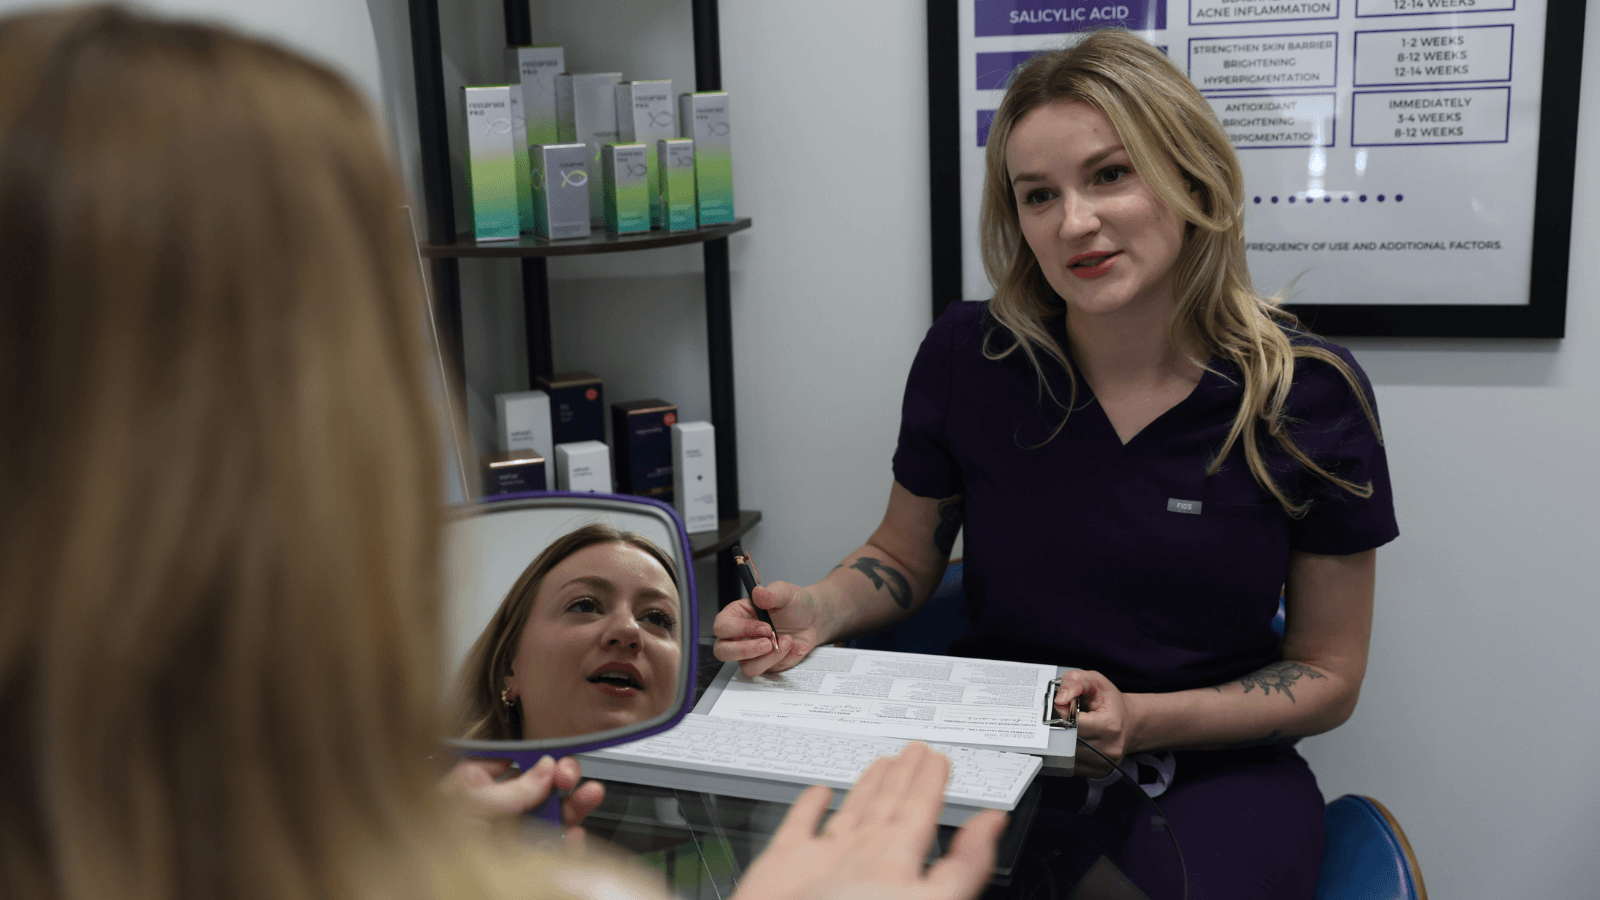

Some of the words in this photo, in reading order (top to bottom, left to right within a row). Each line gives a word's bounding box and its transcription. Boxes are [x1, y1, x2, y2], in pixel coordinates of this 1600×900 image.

[1196, 8, 1231, 18] ACNE
[1234, 3, 1331, 17] INFLAMMATION
[1394, 0, 1423, 9] 12-14
[1428, 0, 1475, 8] WEEKS
[1009, 7, 1086, 24] SALICYLIC
[1089, 5, 1129, 20] ACID
[1193, 43, 1259, 55] STRENGTHEN
[1261, 43, 1285, 52] SKIN
[1288, 40, 1332, 51] BARRIER
[1401, 38, 1417, 48] 1-2
[1420, 36, 1464, 47] WEEKS
[1397, 52, 1420, 62] 8-12
[1423, 50, 1467, 61] WEEKS
[1223, 57, 1296, 69] BRIGHTENING
[1394, 67, 1422, 77] 12-14
[1425, 65, 1469, 76] WEEKS
[1204, 72, 1320, 85] HYPERPIGMENTATION
[1225, 102, 1296, 112] ANTIOXIDANT
[1389, 98, 1472, 109] IMMEDIATELY
[1223, 117, 1295, 127] BRIGHTENING
[1397, 114, 1415, 123] 3-4
[1418, 112, 1461, 123] WEEKS
[1394, 128, 1417, 138] 8-12
[1420, 126, 1463, 137] WEEKS
[1246, 242, 1310, 252] FREQUENCY
[1311, 242, 1326, 251] OF
[1329, 242, 1349, 251] USE
[1352, 242, 1377, 251] AND
[1379, 241, 1446, 251] ADDITIONAL
[1176, 502, 1193, 510] FIGS
